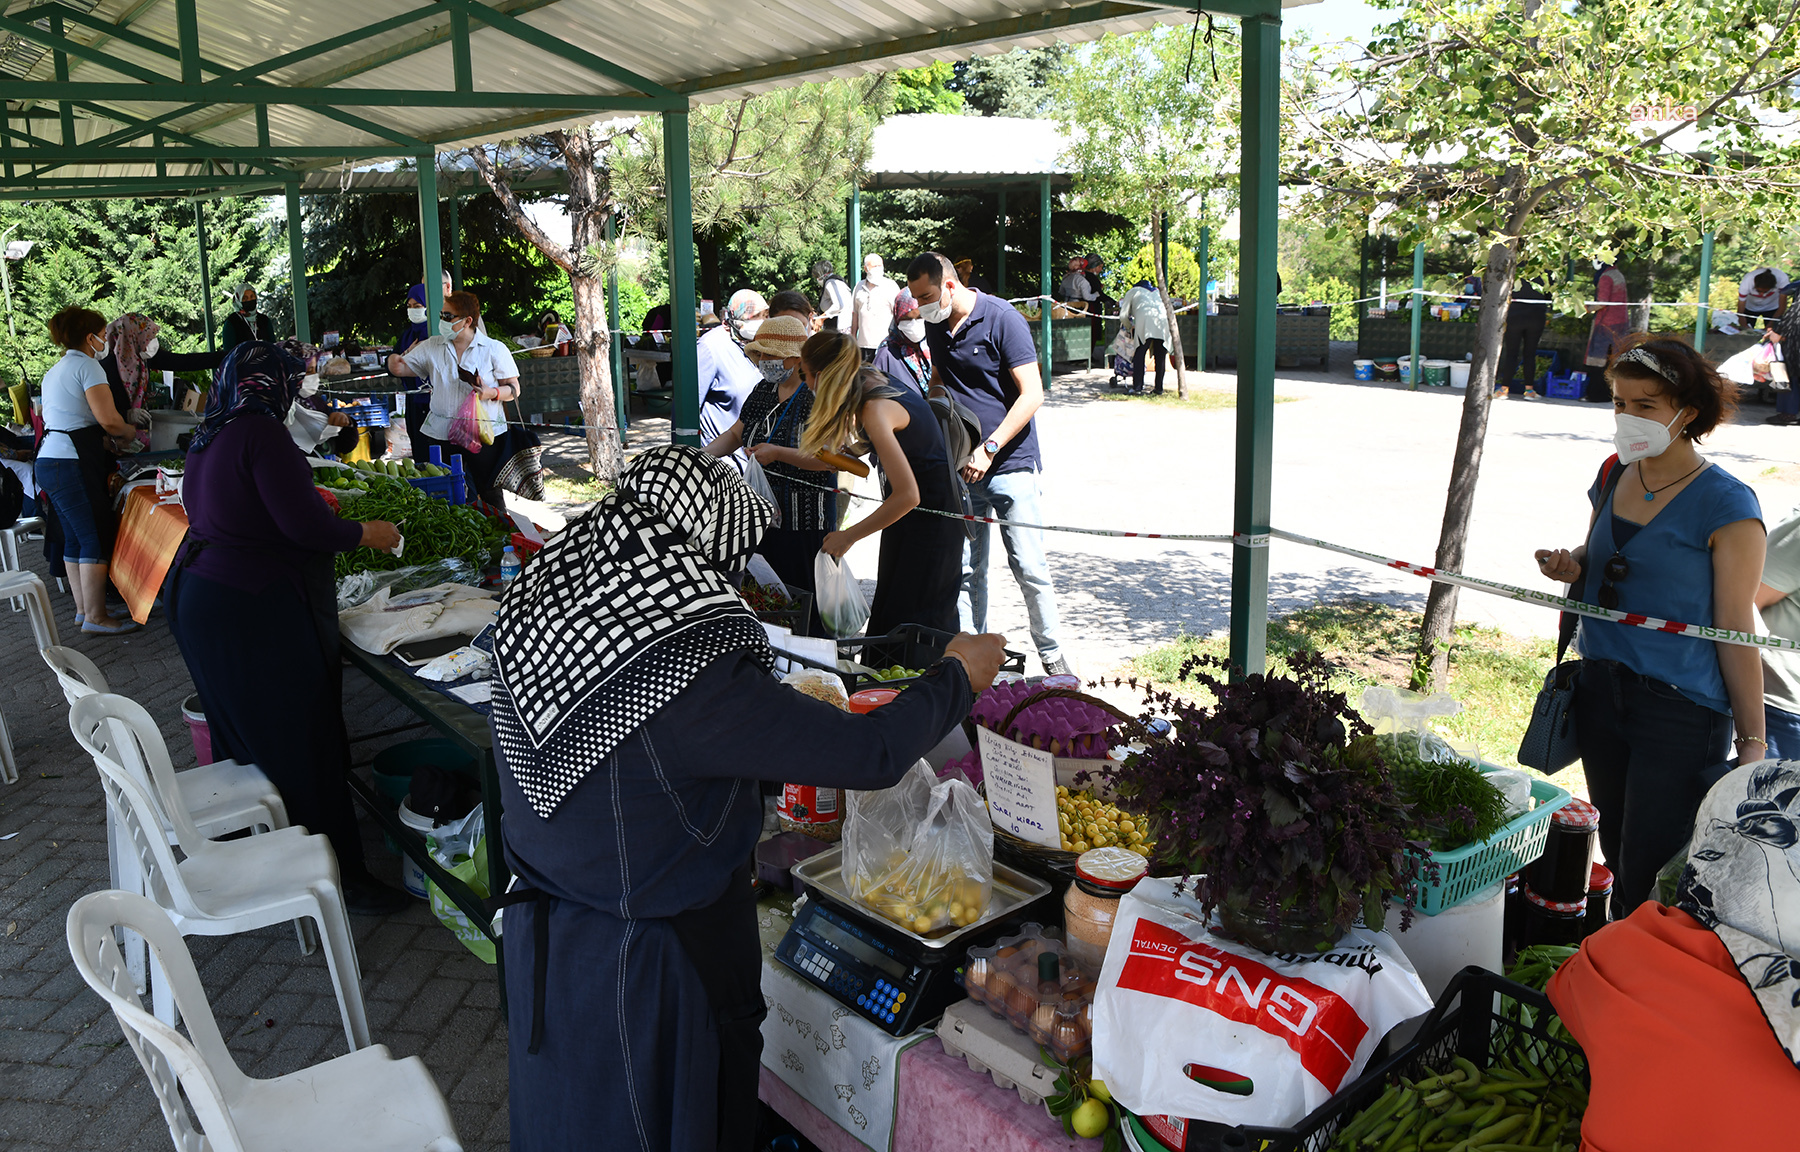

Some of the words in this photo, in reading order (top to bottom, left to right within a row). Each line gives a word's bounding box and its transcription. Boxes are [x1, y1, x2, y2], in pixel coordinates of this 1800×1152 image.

[992, 801, 1012, 818] SARI
[1010, 822, 1020, 833] 10
[1134, 938, 1178, 954] DENTAL
[1174, 950, 1318, 1036] GNS
